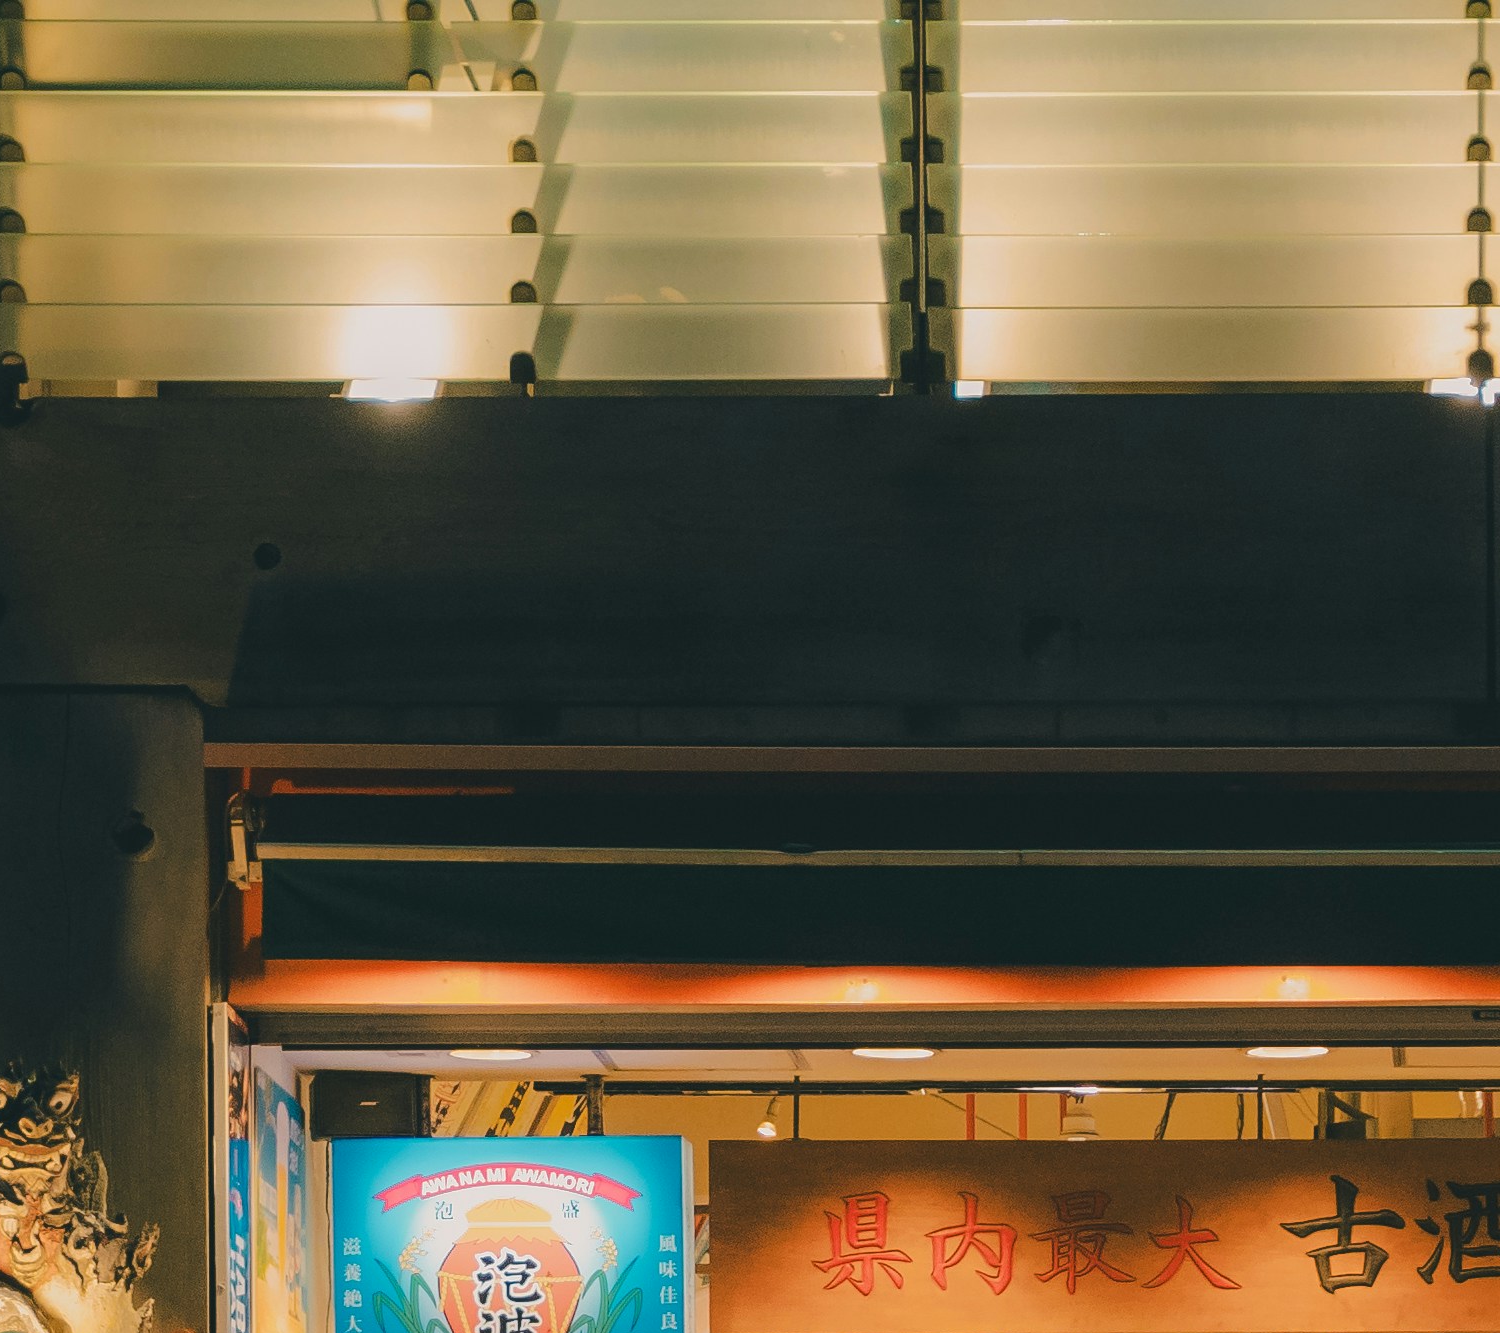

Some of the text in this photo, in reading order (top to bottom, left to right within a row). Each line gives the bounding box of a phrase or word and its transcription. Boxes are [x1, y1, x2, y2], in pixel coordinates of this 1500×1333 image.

[421, 1166, 596, 1196] AWANAMI AWAMORI
[435, 1201, 580, 1220] 泡 盛
[343, 1237, 363, 1333] 滋養絶大
[658, 1234, 678, 1331] 風味佳良
[811, 1189, 1244, 1298] 県内最大
